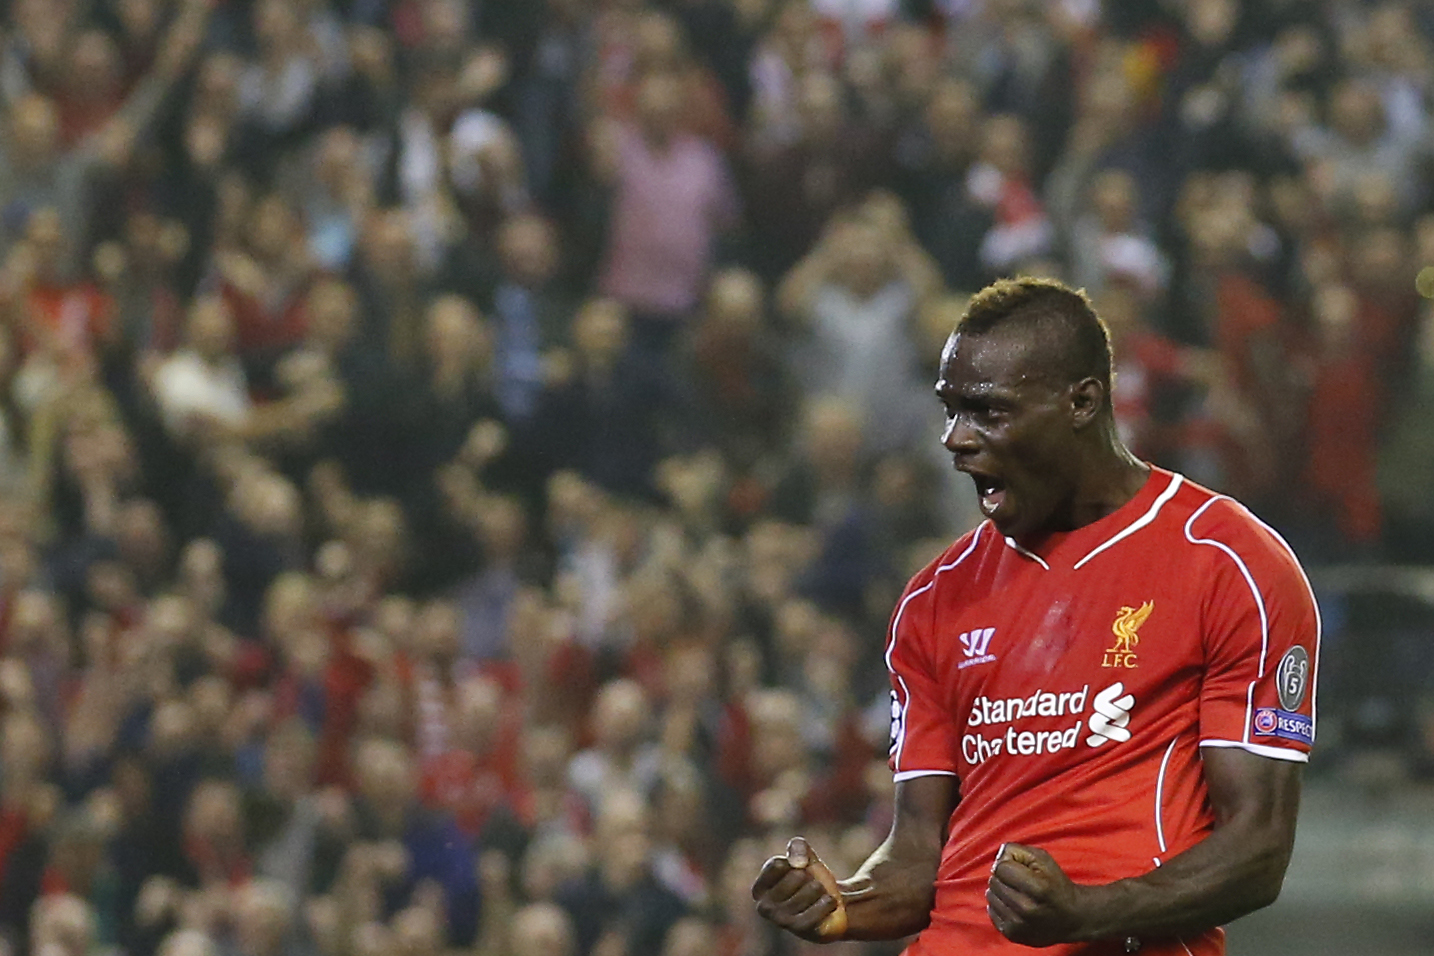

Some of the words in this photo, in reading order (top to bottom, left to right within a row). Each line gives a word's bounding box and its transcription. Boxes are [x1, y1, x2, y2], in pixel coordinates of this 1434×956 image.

[1288, 677, 1299, 695] 5
[967, 684, 1089, 727] Standard
[1278, 717, 1313, 737] RESPEC
